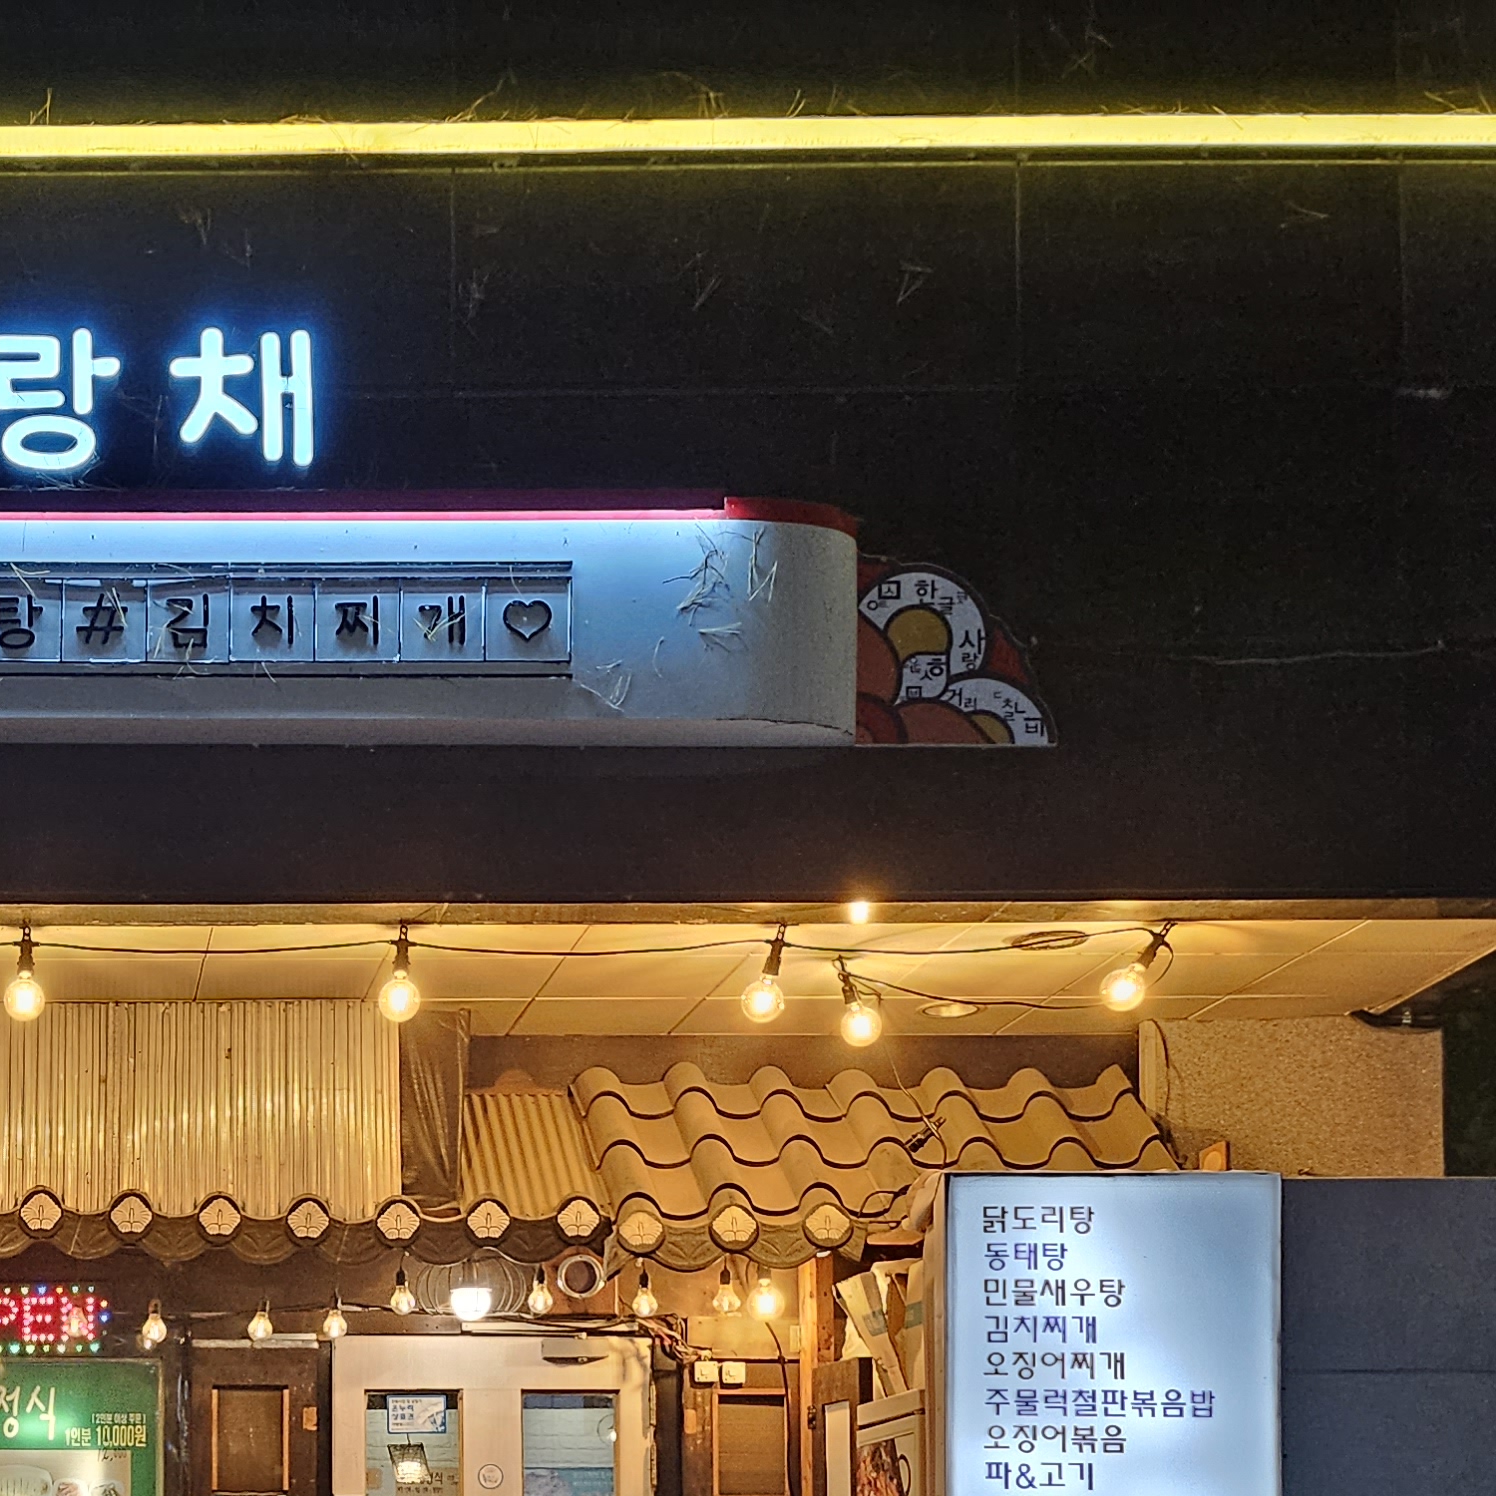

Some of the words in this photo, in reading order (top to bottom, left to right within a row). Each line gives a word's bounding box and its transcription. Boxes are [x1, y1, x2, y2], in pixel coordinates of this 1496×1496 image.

[981, 1204, 1096, 1235] 닭도리탕
[983, 1241, 1068, 1272] 동태탕
[983, 1278, 1126, 1308] 민물새우탕
[984, 1315, 1098, 1345] 김치찌개
[983, 1351, 1126, 1381] 오징어찌개
[984, 1388, 1216, 1418] 주물럭철판볶음밥
[65, 1427, 91, 1447] 1인분
[95, 1425, 147, 1448] 10,000원
[983, 1424, 1128, 1454] 오징어볶음
[984, 1461, 1096, 1491] 파&고기
